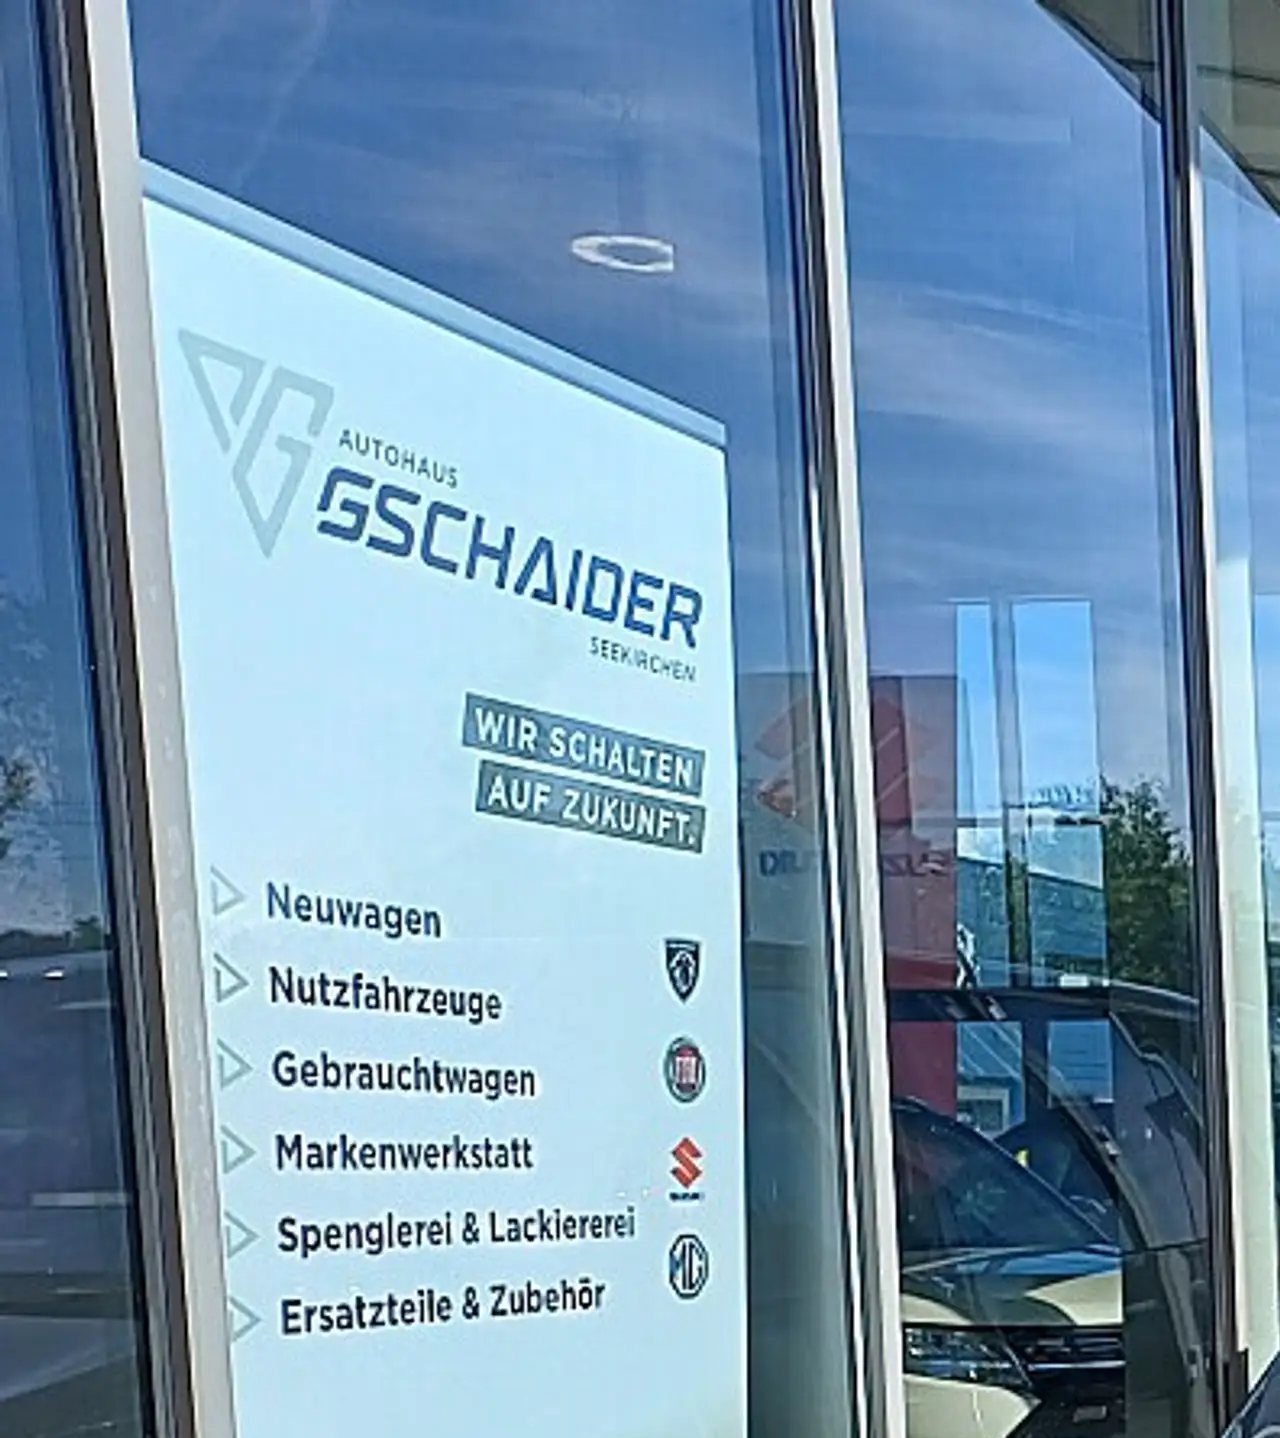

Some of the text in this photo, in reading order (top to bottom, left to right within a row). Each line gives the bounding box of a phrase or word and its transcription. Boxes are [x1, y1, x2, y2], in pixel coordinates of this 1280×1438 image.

[338, 427, 460, 490] AUTOHAUS
[316, 466, 704, 649] GSCHAIDER
[588, 634, 698, 683] SEEKIRCHEN
[473, 706, 695, 788] WIR SCHALTEN
[485, 775, 698, 847] AUF ZUKUNFT.
[266, 881, 442, 940] Neuwagen
[269, 965, 503, 1024] Nutzfahrzeuge
[271, 1049, 536, 1101] Gebrauchtwagen
[275, 1133, 534, 1173] Markenwerkstatt
[277, 1206, 637, 1259] Spenglerei & Lackiererei
[281, 1277, 606, 1336] Ersatzteile & Zubehör
